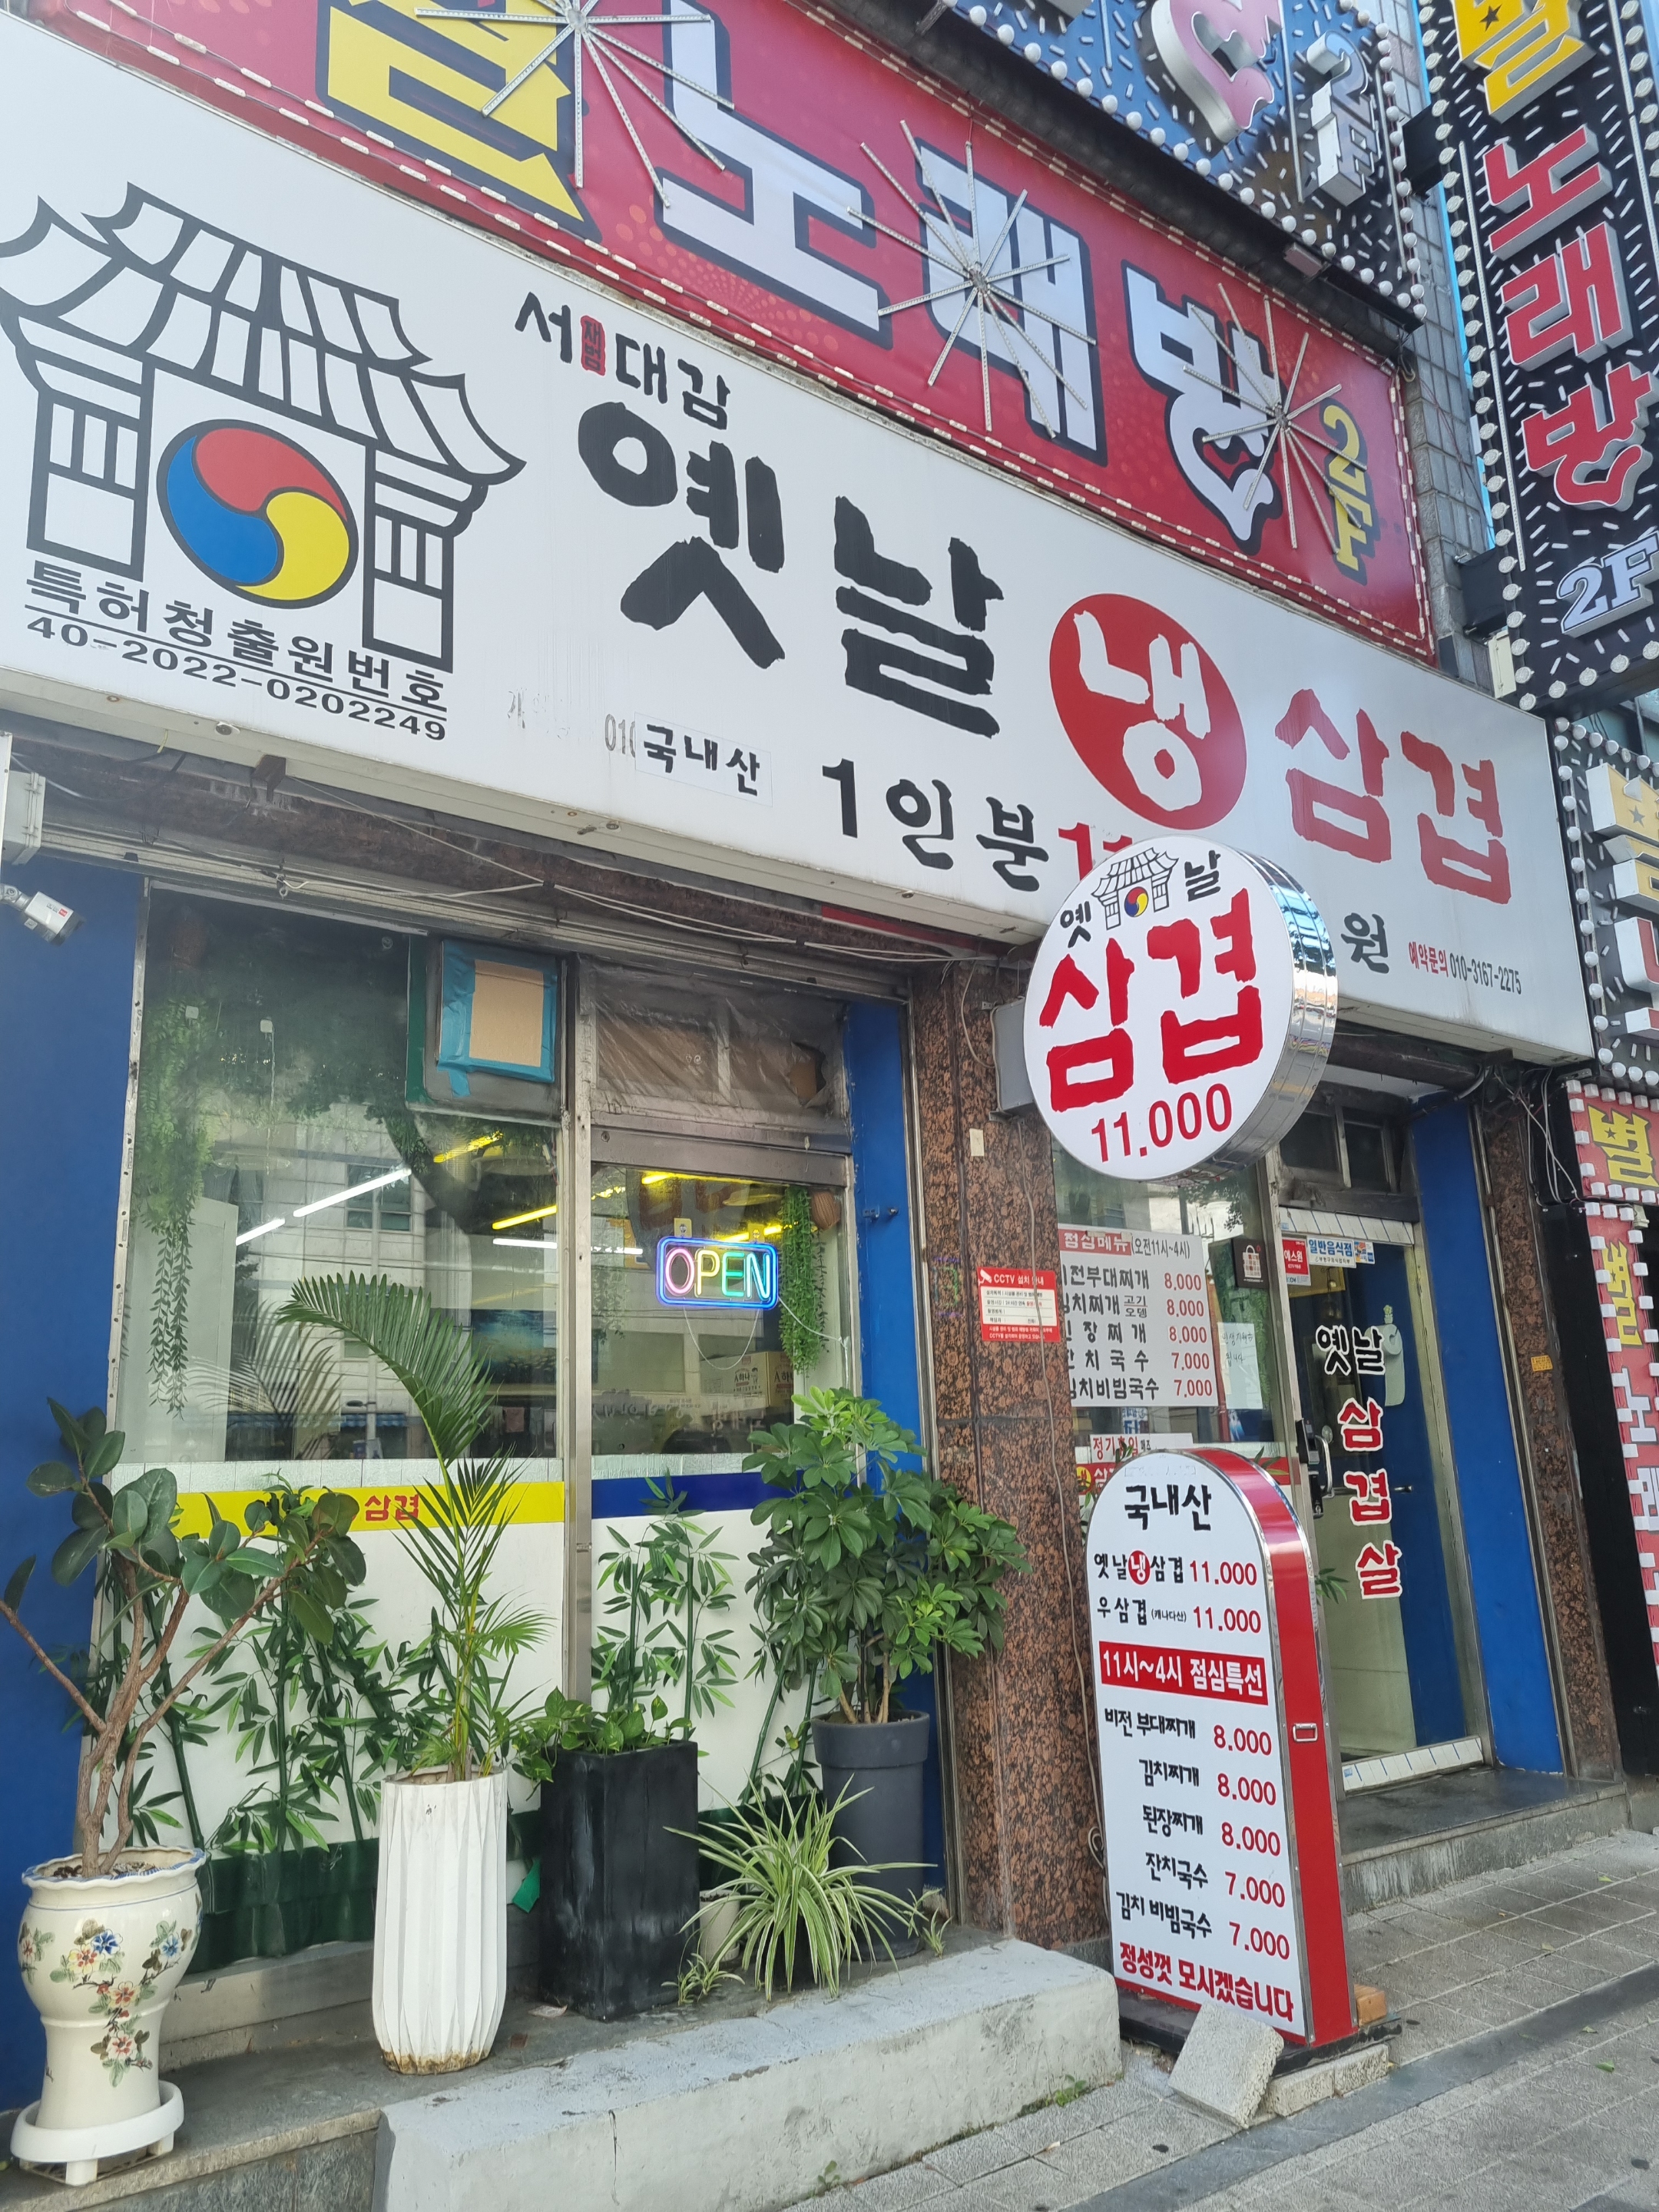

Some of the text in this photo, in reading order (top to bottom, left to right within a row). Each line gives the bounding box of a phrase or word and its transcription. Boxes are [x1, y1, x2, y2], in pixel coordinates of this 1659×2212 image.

[1321, 404, 1369, 571] 2F
[1556, 532, 1659, 634] 2F
[26, 560, 449, 713] 특허청출원번호
[26, 617, 446, 741] 40-2022-0202249
[644, 724, 760, 796] 국내산
[1341, 912, 1389, 974] 원
[1409, 941, 1522, 995] 예약문의 010-3167-2275
[1039, 888, 1263, 1112] 삼겹
[1091, 1083, 1232, 1163] 11.000
[1064, 1232, 1129, 1253] 점심메뉴
[1308, 1239, 1353, 1257] 일반음식점
[664, 1247, 770, 1301] OPEN
[993, 1273, 1015, 1284] CCTV
[1164, 1272, 1202, 1291] 8.000
[1166, 1299, 1205, 1317] 8.000
[1168, 1326, 1207, 1344] 8.000
[1316, 1325, 1386, 1376] 옛날
[1171, 1352, 1210, 1371] 7.000
[1173, 1379, 1213, 1398] 7.000
[1124, 1484, 1211, 1531] 국내산
[1190, 1560, 1257, 1586] 11.000
[1097, 1596, 1147, 1626] 우삼겹
[1193, 1606, 1261, 1634] 11.000
[1103, 1650, 1263, 1697] 11시~4시 점심특선
[1214, 1724, 1272, 1756] 8.000
[1138, 1759, 1277, 1806] 김치찌개 8.000
[1142, 1804, 1281, 1856] 된장찌개 8.000
[1145, 1852, 1286, 1908] 잔치국수 7.000
[1229, 1921, 1290, 1960] 7.000
[1119, 1942, 1294, 2022] 정성껏 모시겠습니다
